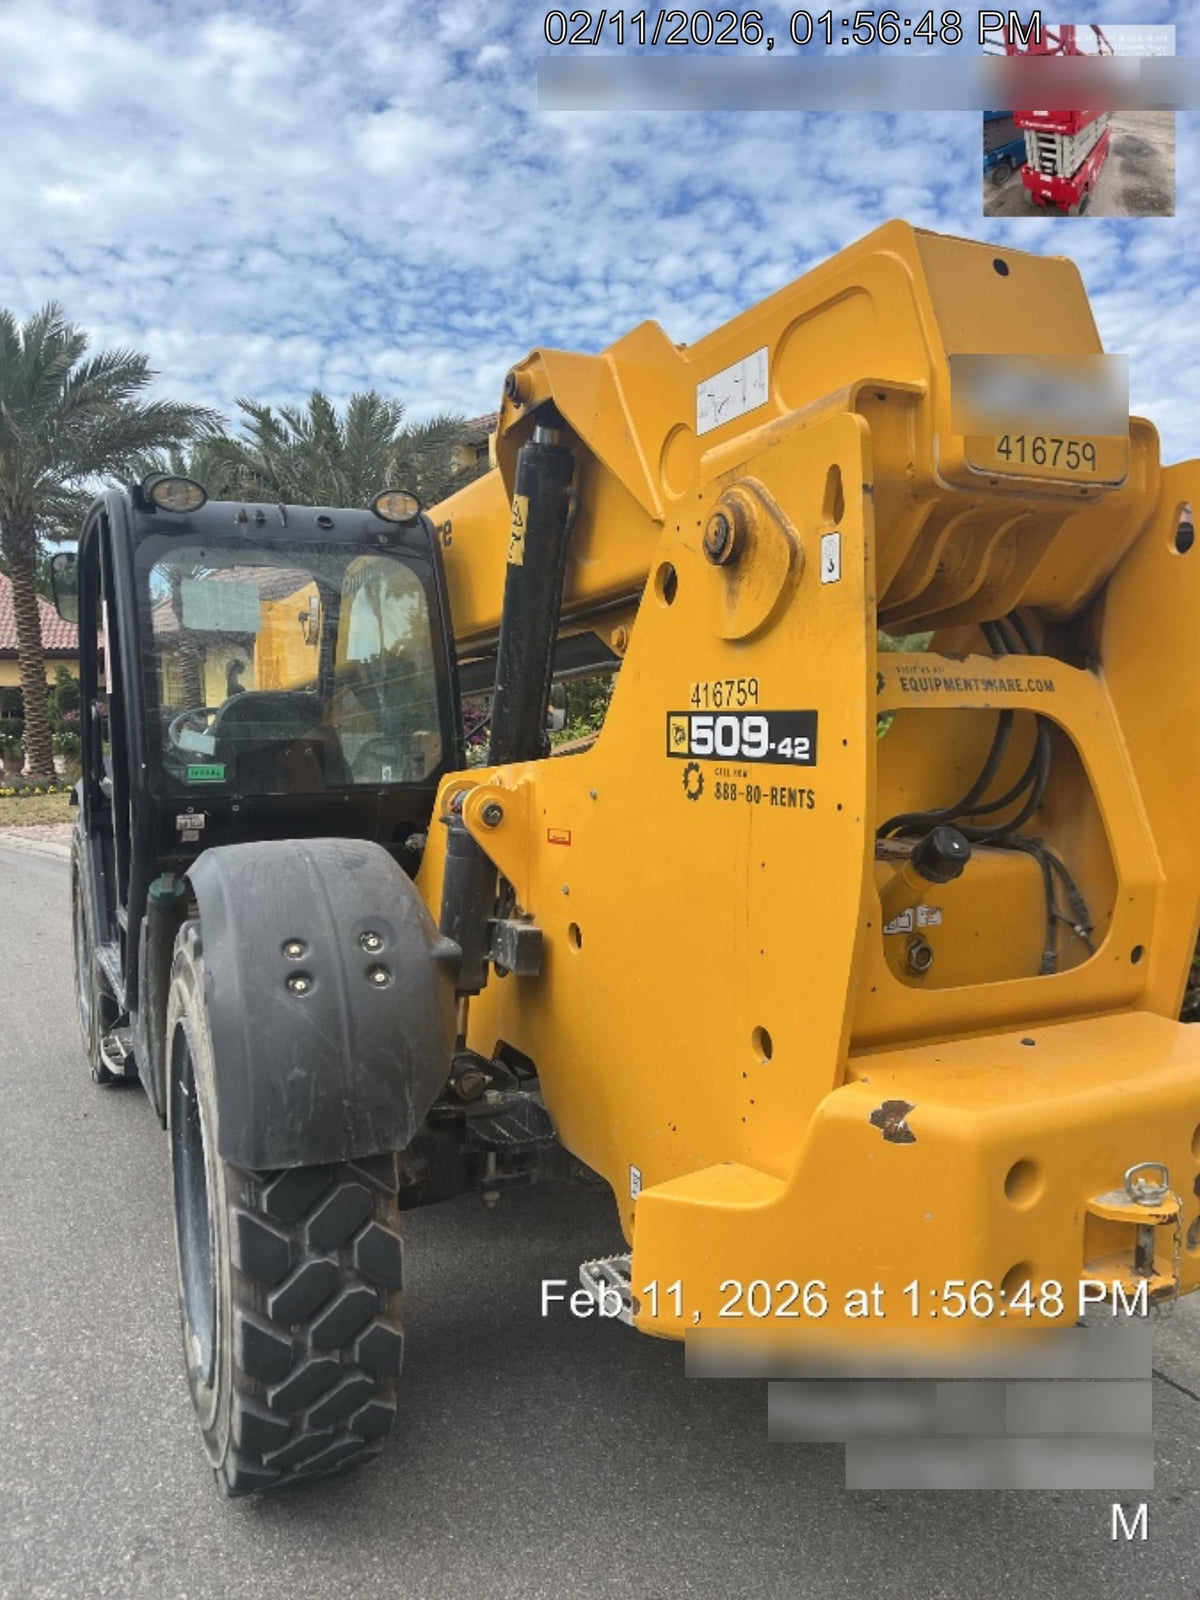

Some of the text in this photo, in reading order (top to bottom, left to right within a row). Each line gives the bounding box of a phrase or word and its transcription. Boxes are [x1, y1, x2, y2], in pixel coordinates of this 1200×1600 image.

[996, 435, 1096, 472] 416759
[690, 678, 759, 709] 416759
[713, 781, 816, 810] 888-80-RENTS
